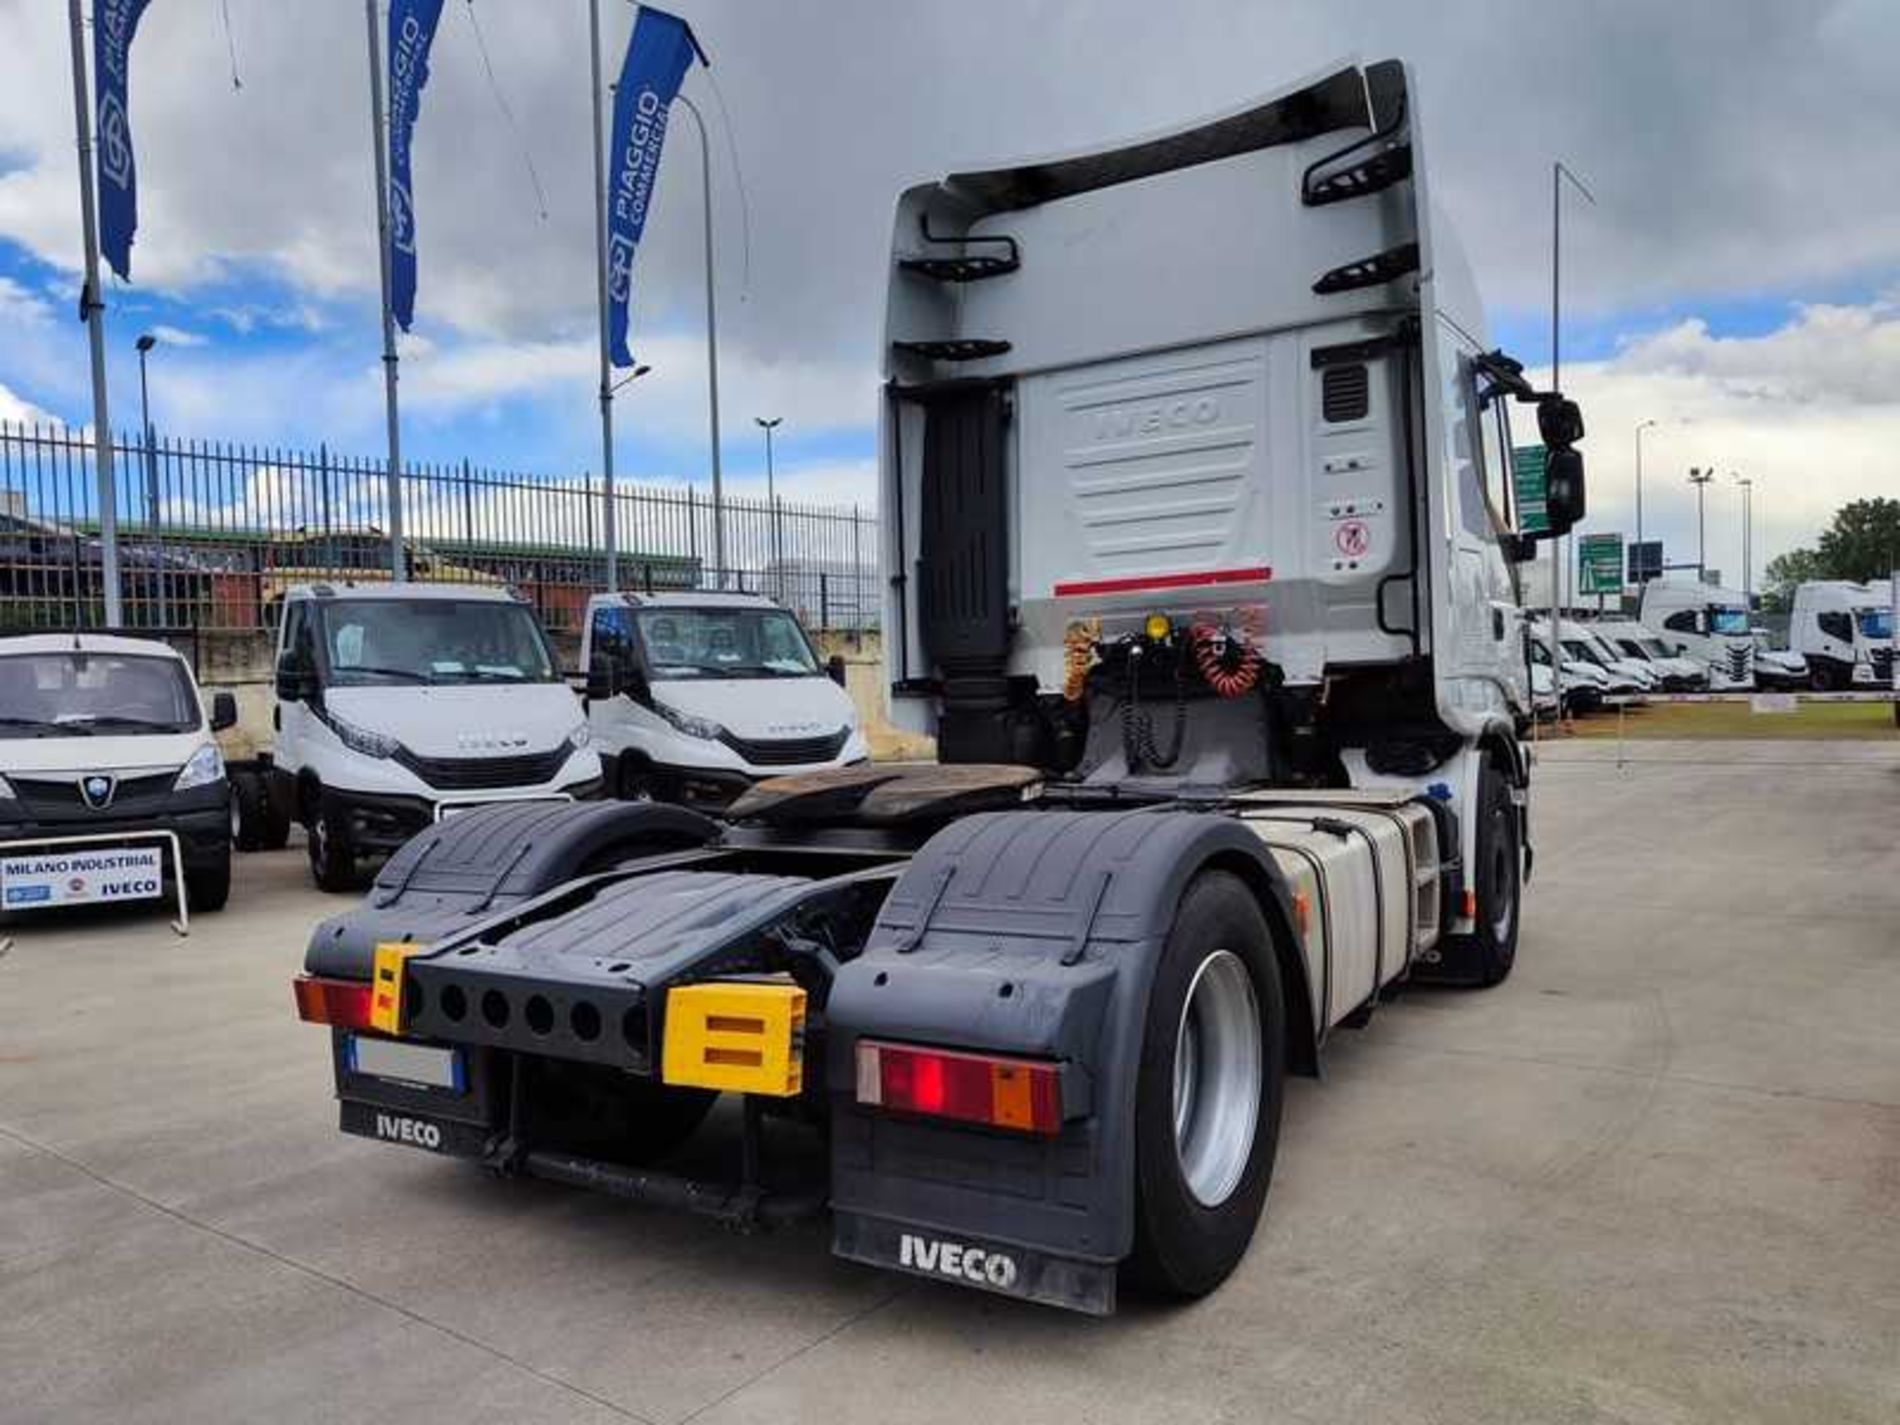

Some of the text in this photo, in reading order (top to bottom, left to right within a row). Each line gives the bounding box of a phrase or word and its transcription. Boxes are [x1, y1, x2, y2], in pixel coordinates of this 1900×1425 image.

[617, 91, 658, 219] PIAGGIO
[6, 854, 156, 876] MILANO INDUSTRIAL
[101, 880, 157, 896] IVECO
[376, 1114, 441, 1148] IVECO
[900, 1233, 1018, 1289] IVECO
